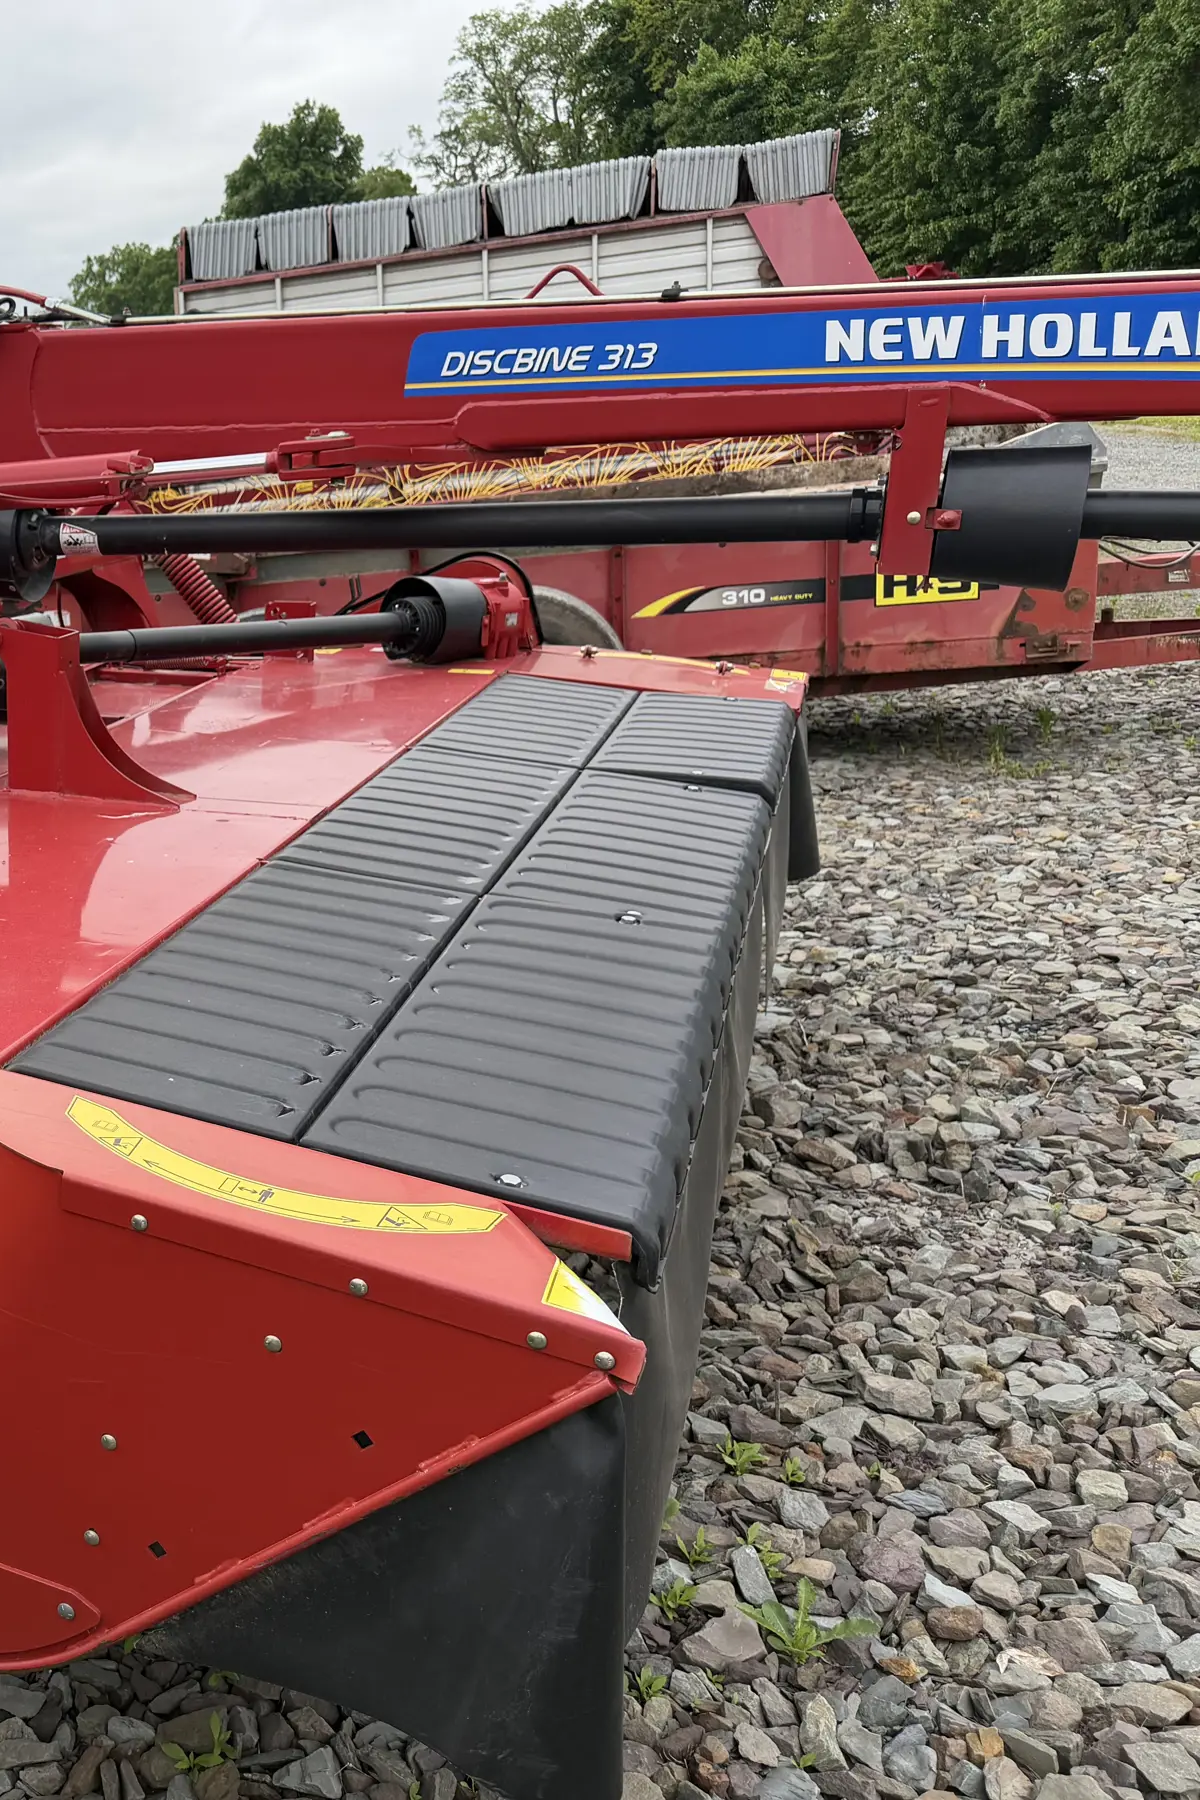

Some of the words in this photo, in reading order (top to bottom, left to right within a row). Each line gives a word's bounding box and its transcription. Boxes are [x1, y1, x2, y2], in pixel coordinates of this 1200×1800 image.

[825, 315, 965, 362] NEW
[981, 310, 1200, 358] HOLLA
[440, 345, 594, 377] DISCBINE
[598, 342, 658, 371] 313
[722, 588, 766, 605] 310
[770, 594, 793, 602] HEAVY
